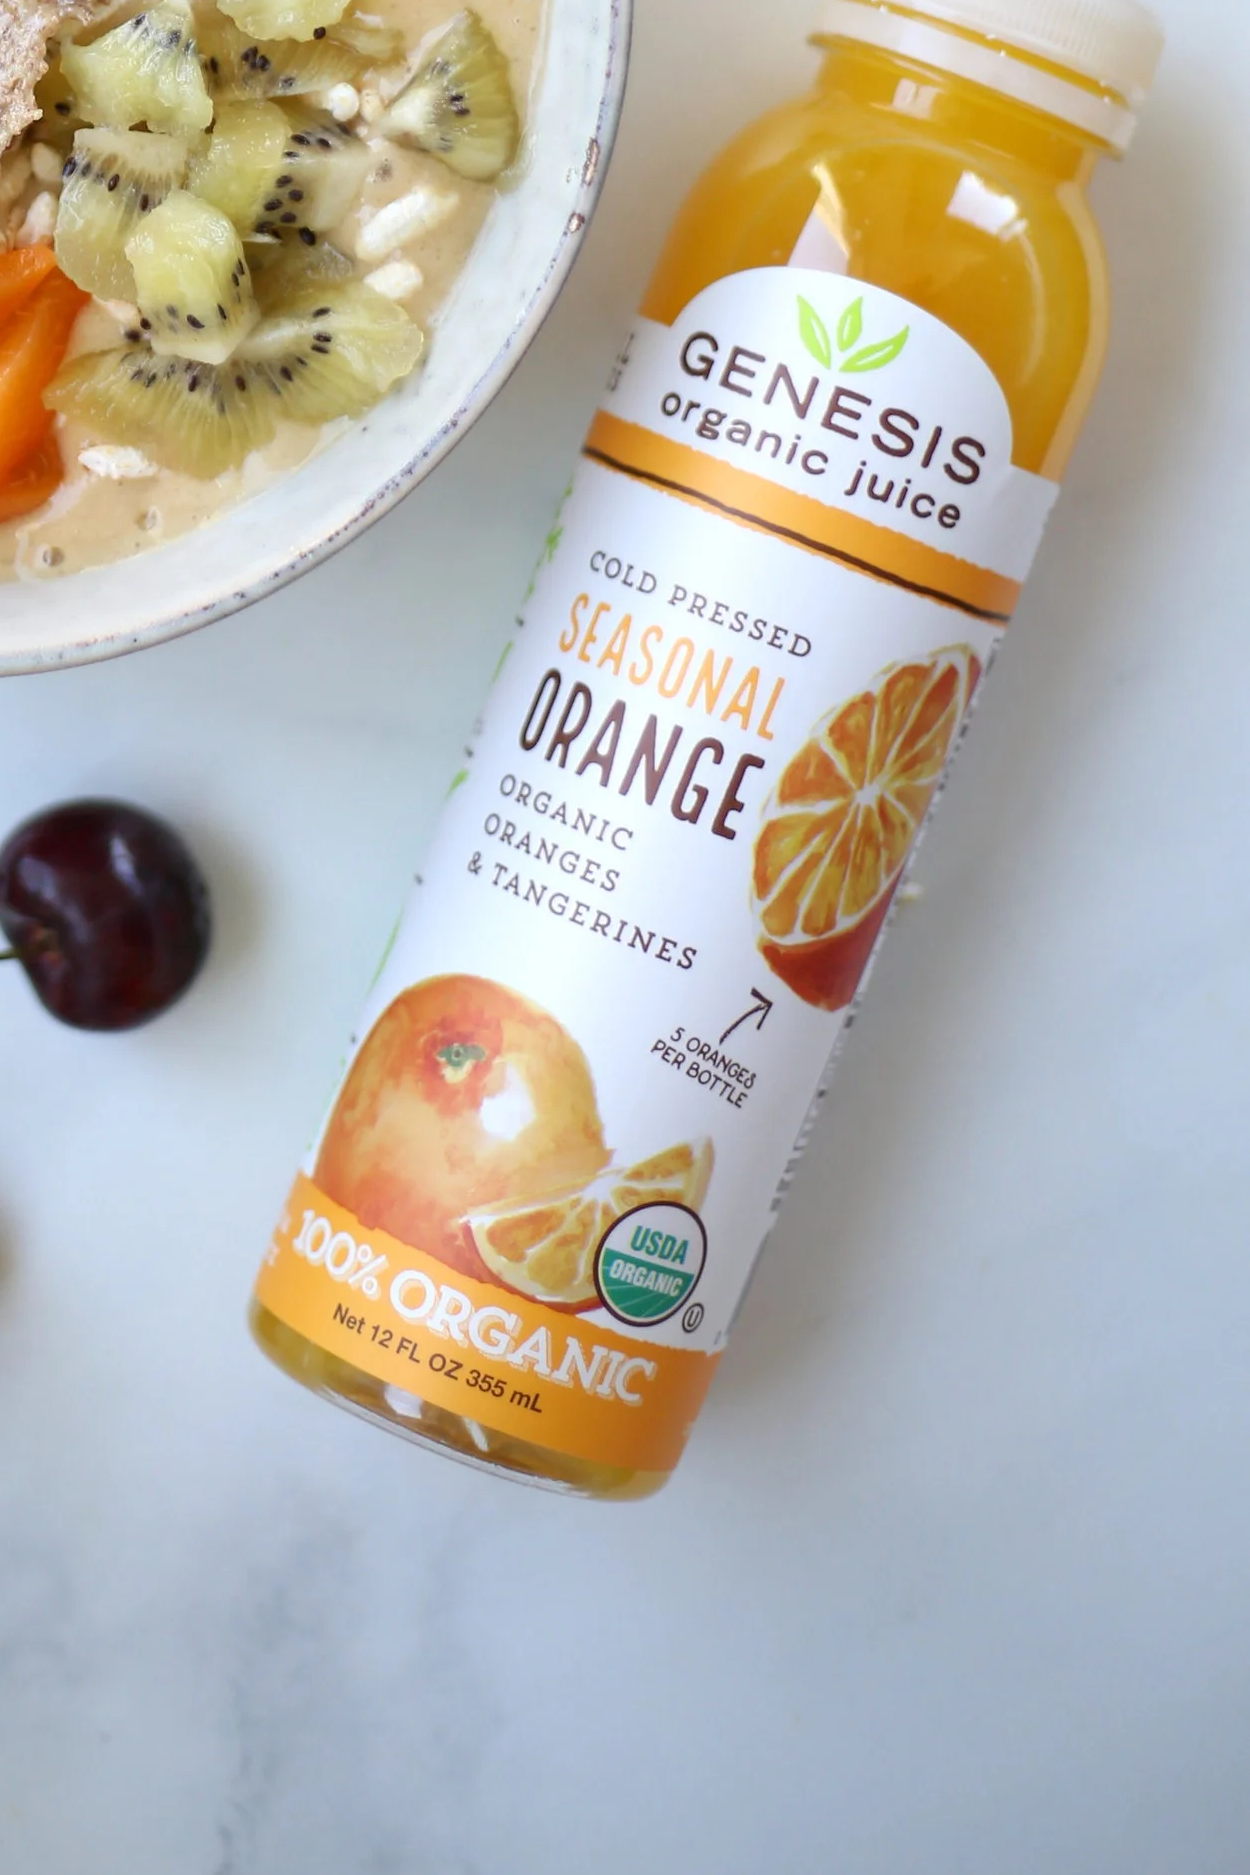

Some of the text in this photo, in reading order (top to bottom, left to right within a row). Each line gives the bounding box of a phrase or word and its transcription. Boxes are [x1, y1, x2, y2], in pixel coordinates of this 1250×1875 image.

[660, 390, 962, 530] organic juice
[679, 331, 987, 485] GENESIS
[588, 549, 813, 659] COLD PRESSED
[558, 592, 786, 741] SEASONAL
[518, 667, 765, 841] ORANGE
[483, 812, 621, 893] ORANGES
[498, 773, 634, 852] ORGANIC
[466, 850, 698, 971] & TANGERINES
[650, 1039, 748, 1109] PER BOTTLE
[669, 1026, 757, 1090] 5 ORANGES
[609, 1258, 684, 1298] ORGANIC
[629, 1224, 690, 1265] USDA
[291, 1209, 389, 1300] 100%
[389, 1269, 656, 1405] ORGANIC
[332, 1302, 544, 1414] Net 12 FL OZ 355 mL
